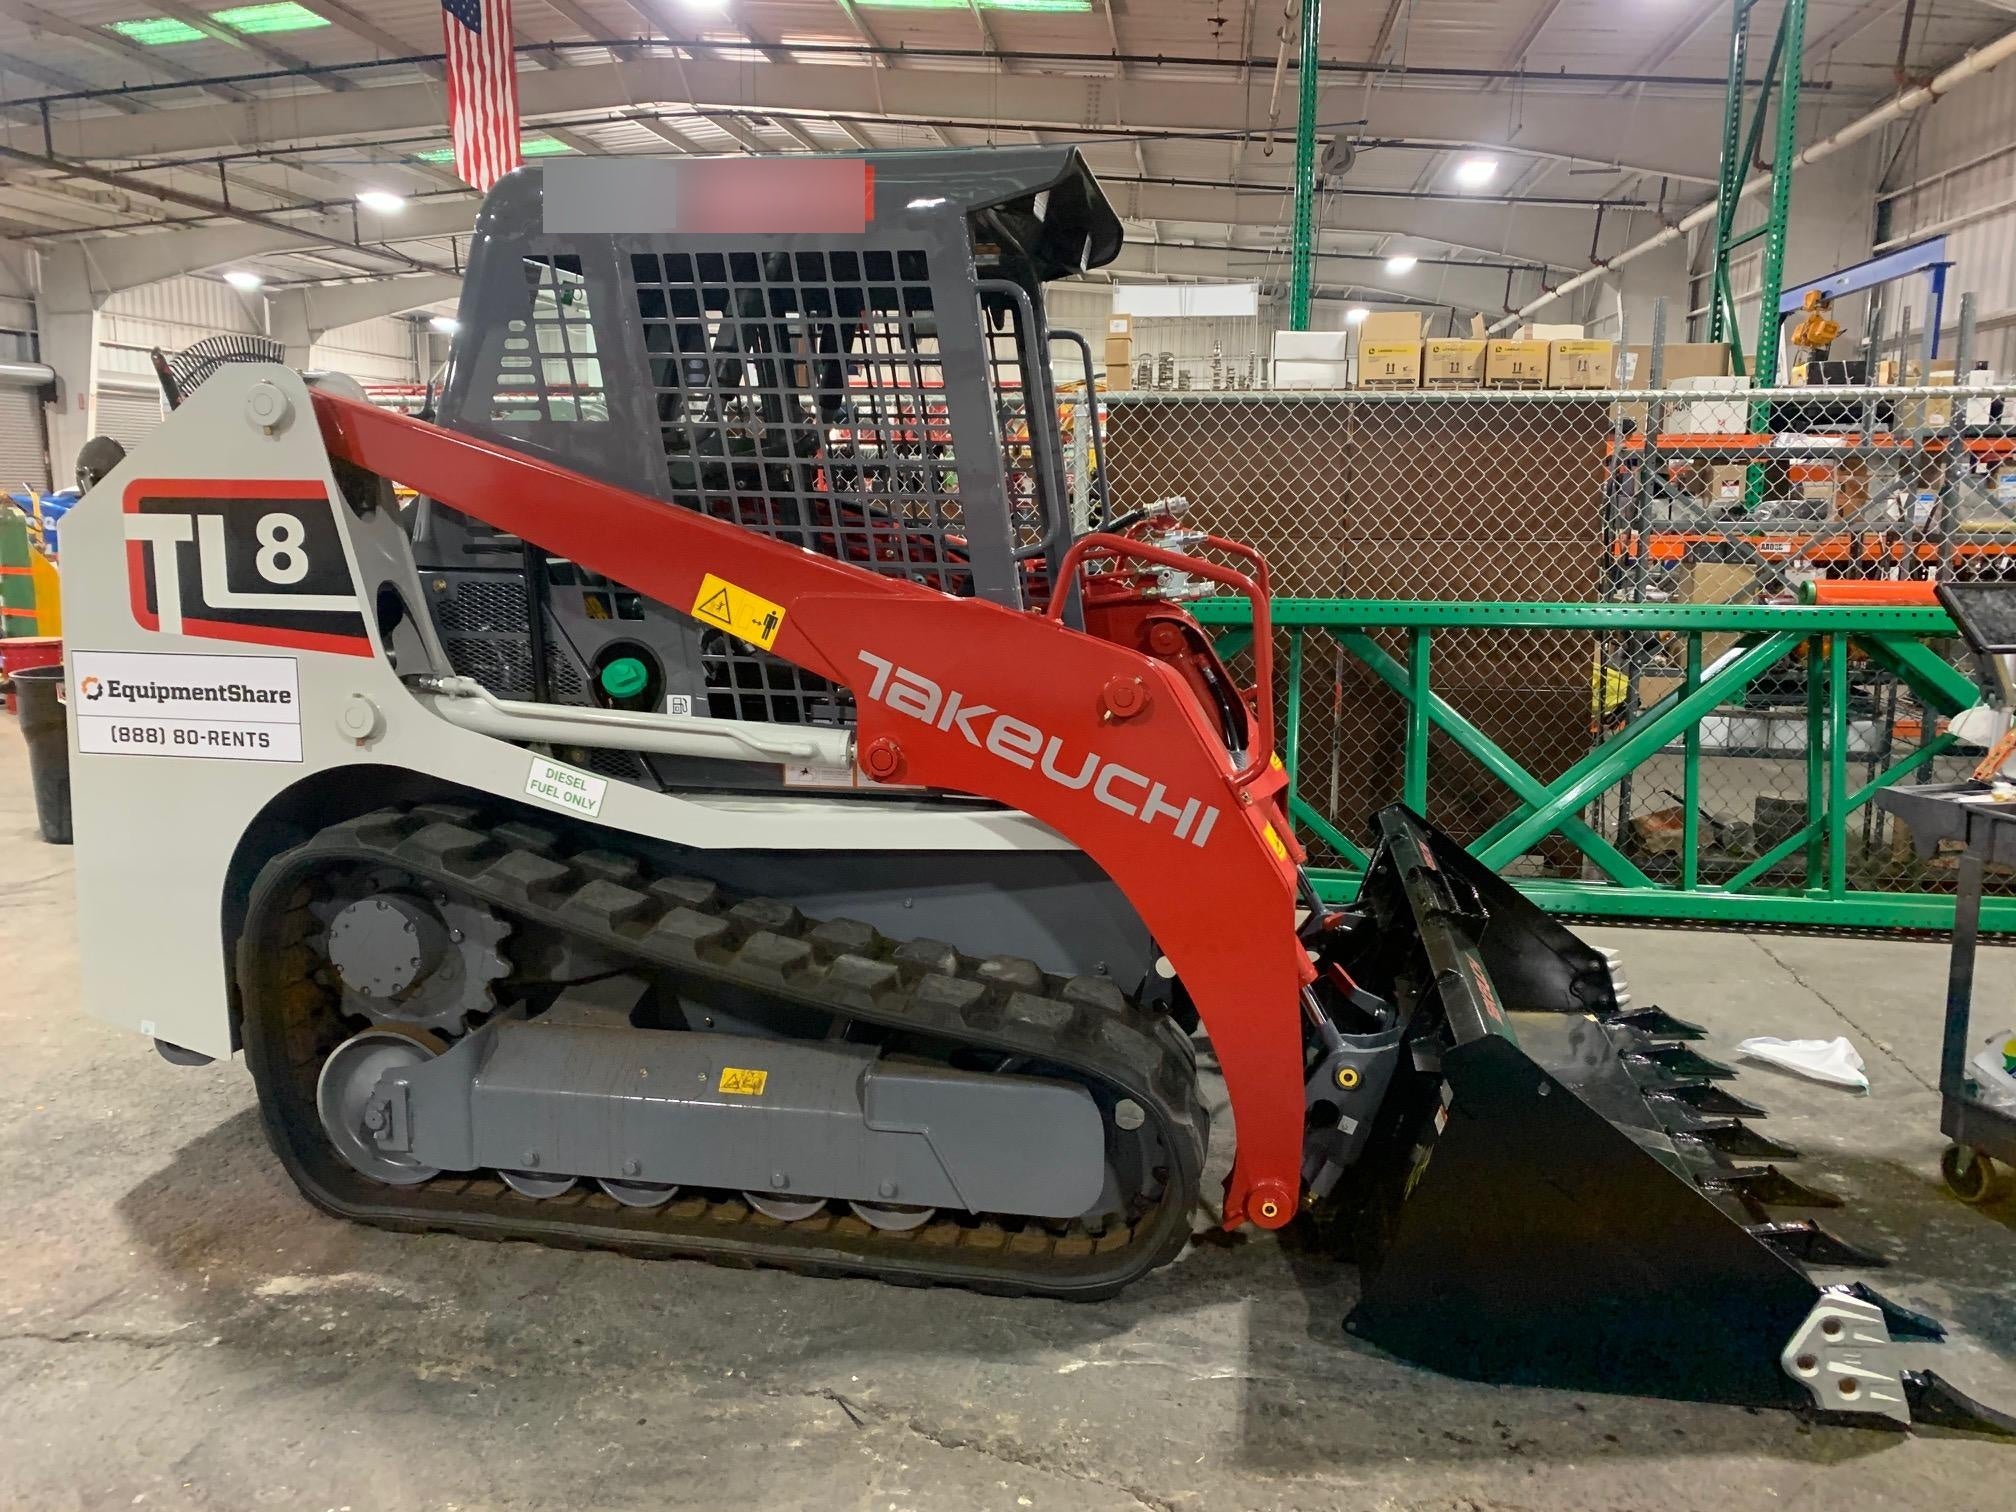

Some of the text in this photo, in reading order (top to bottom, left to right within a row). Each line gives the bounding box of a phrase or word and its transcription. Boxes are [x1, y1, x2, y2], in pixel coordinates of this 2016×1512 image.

[107, 680, 292, 704] EquipmentShare
[111, 725, 270, 748] (888) 80-RENTS
[545, 768, 587, 791] DIESEL
[530, 779, 597, 810] FUEL ONLY
